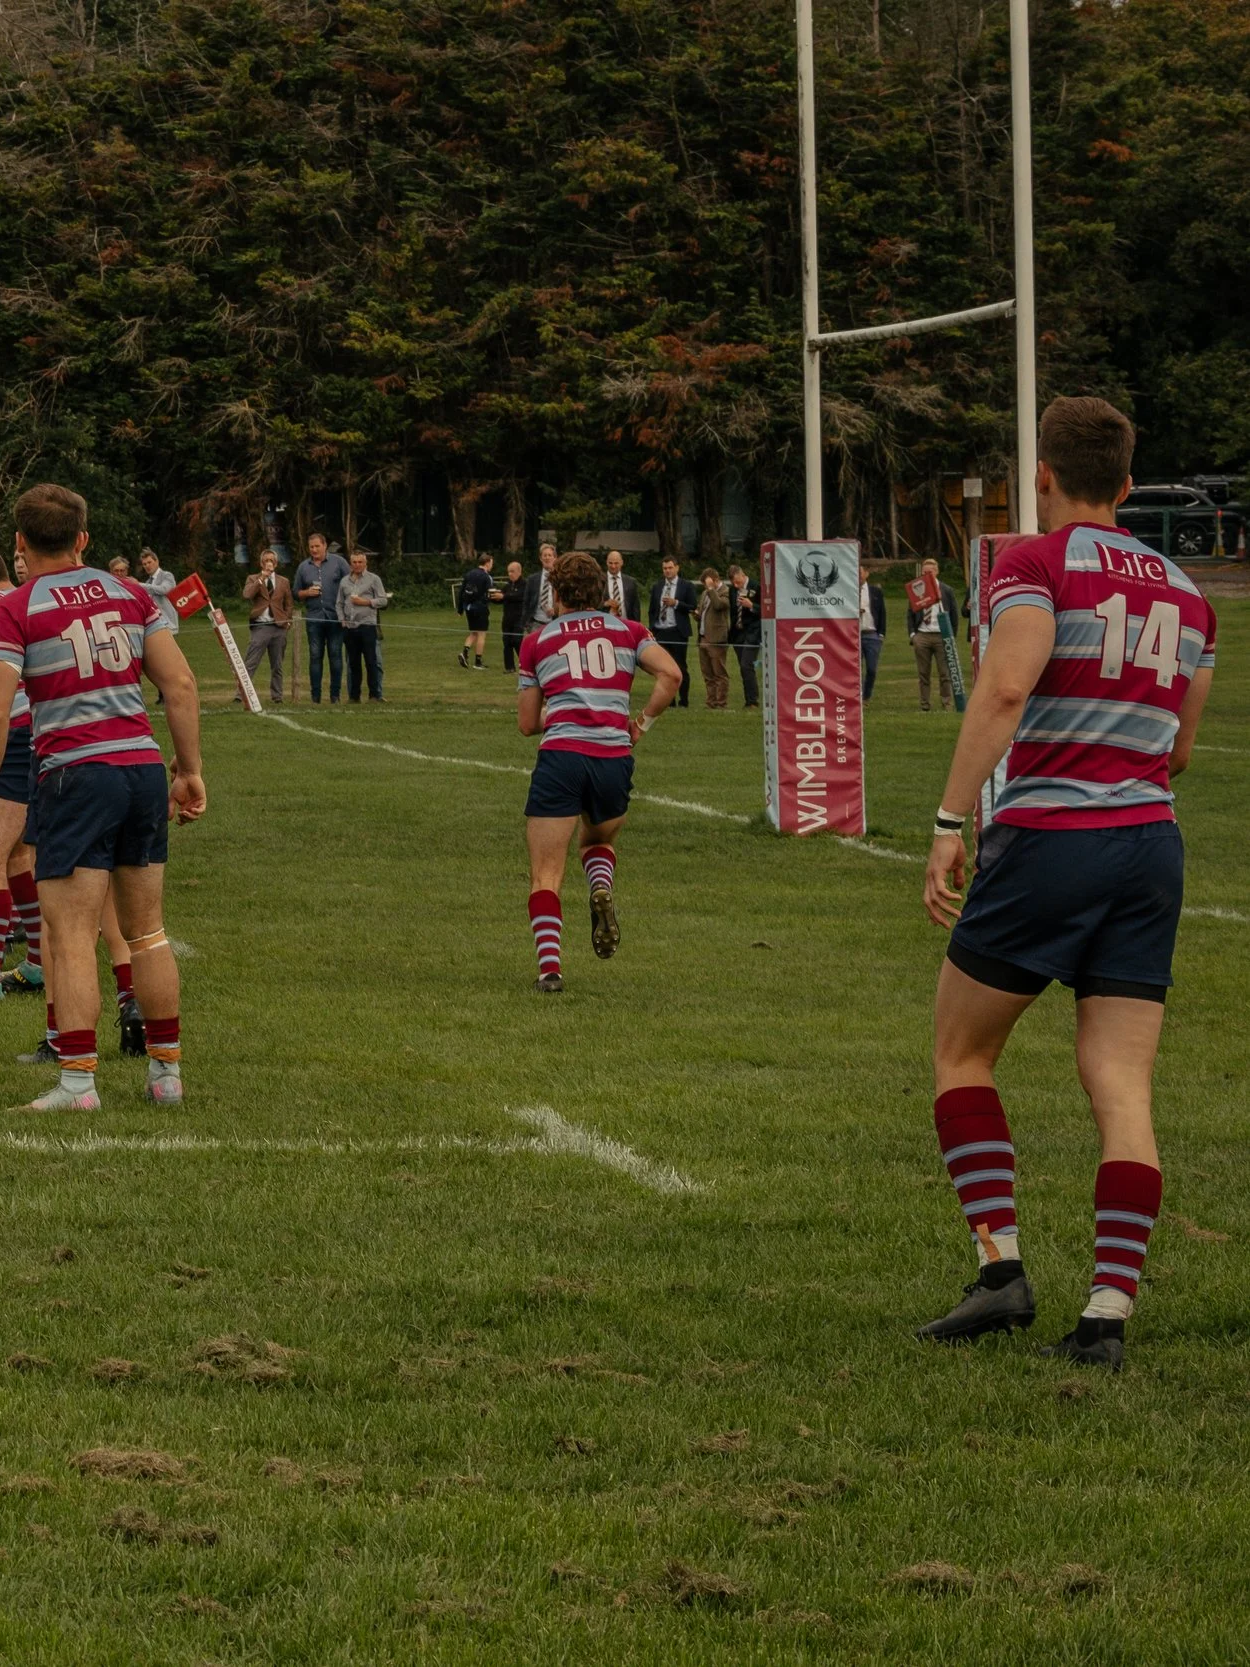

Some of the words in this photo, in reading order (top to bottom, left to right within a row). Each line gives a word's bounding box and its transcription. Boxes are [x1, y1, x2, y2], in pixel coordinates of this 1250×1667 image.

[1100, 543, 1164, 581] Life
[54, 583, 105, 605] Life
[791, 597, 845, 607] WIMBLEDON
[60, 611, 133, 680] 15
[564, 618, 602, 632] Life
[1095, 592, 1180, 690] 14
[558, 637, 617, 680] 10
[943, 637, 963, 696] POWERGEN
[793, 626, 829, 835] WIMBLEDON
[836, 696, 847, 764] BREWERY
